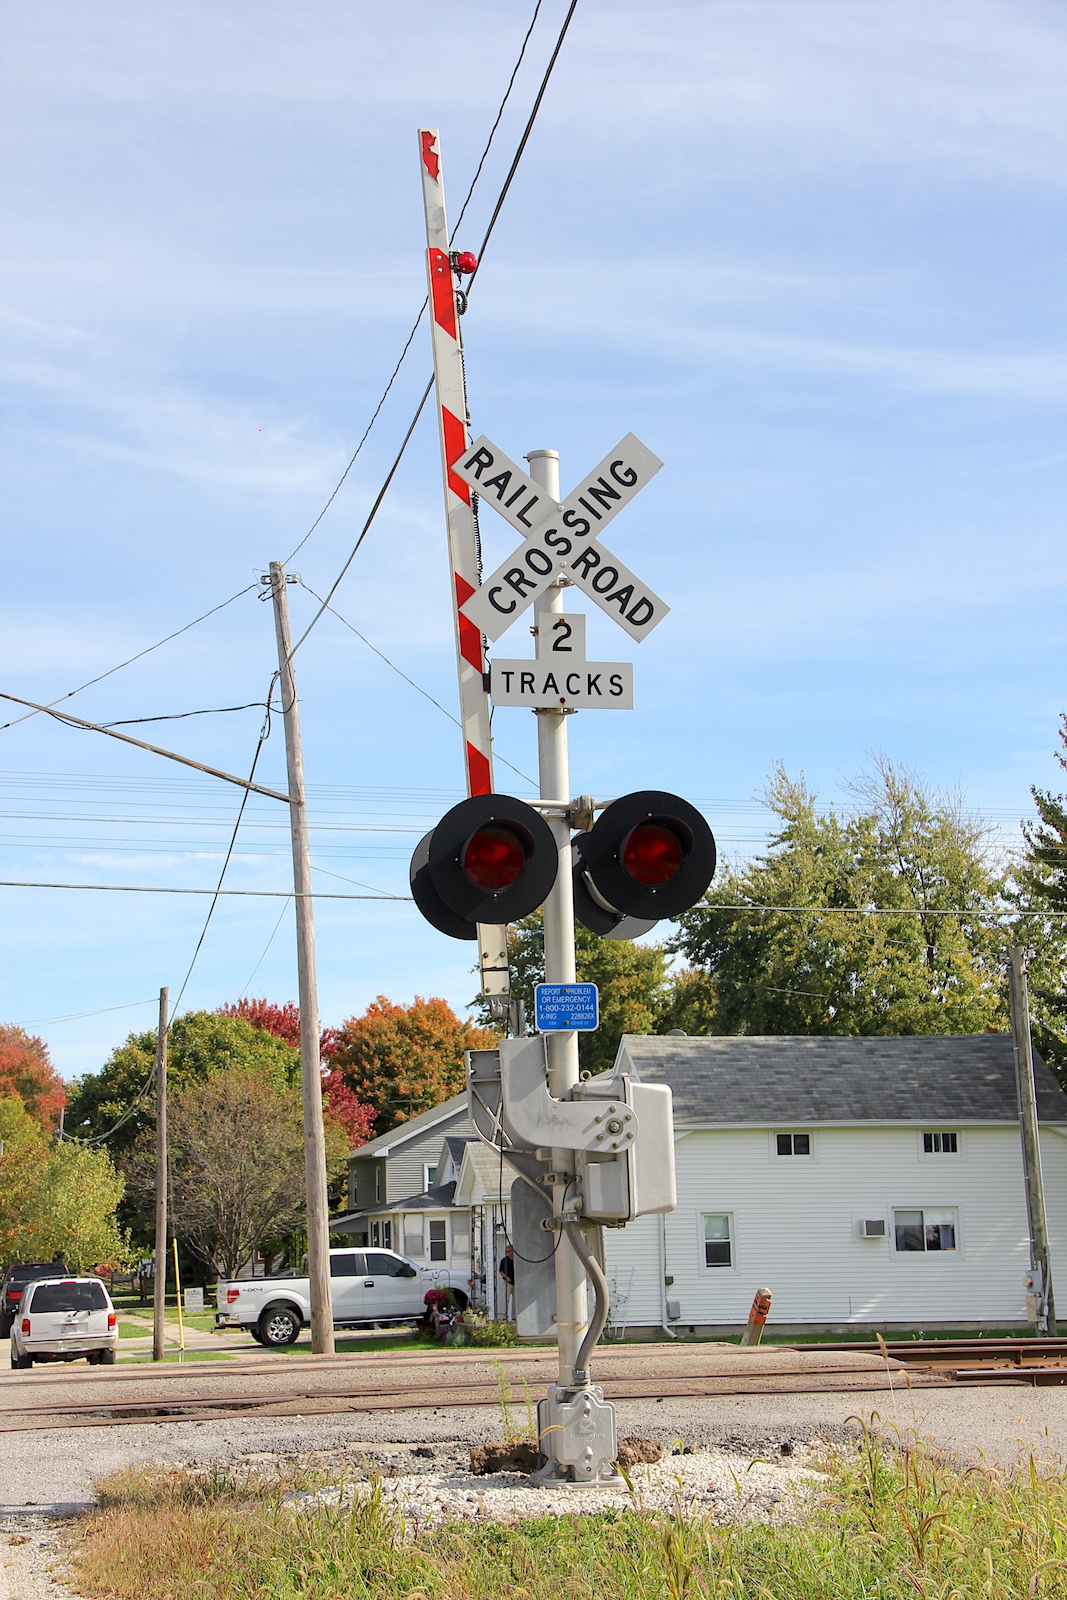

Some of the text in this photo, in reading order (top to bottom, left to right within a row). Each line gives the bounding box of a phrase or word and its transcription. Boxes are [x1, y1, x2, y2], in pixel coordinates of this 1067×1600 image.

[464, 446, 538, 528] RAIL
[488, 460, 638, 614] CROSSING
[570, 546, 654, 626] ROAD
[552, 624, 572, 651] 2
[501, 671, 624, 696] TRACKS
